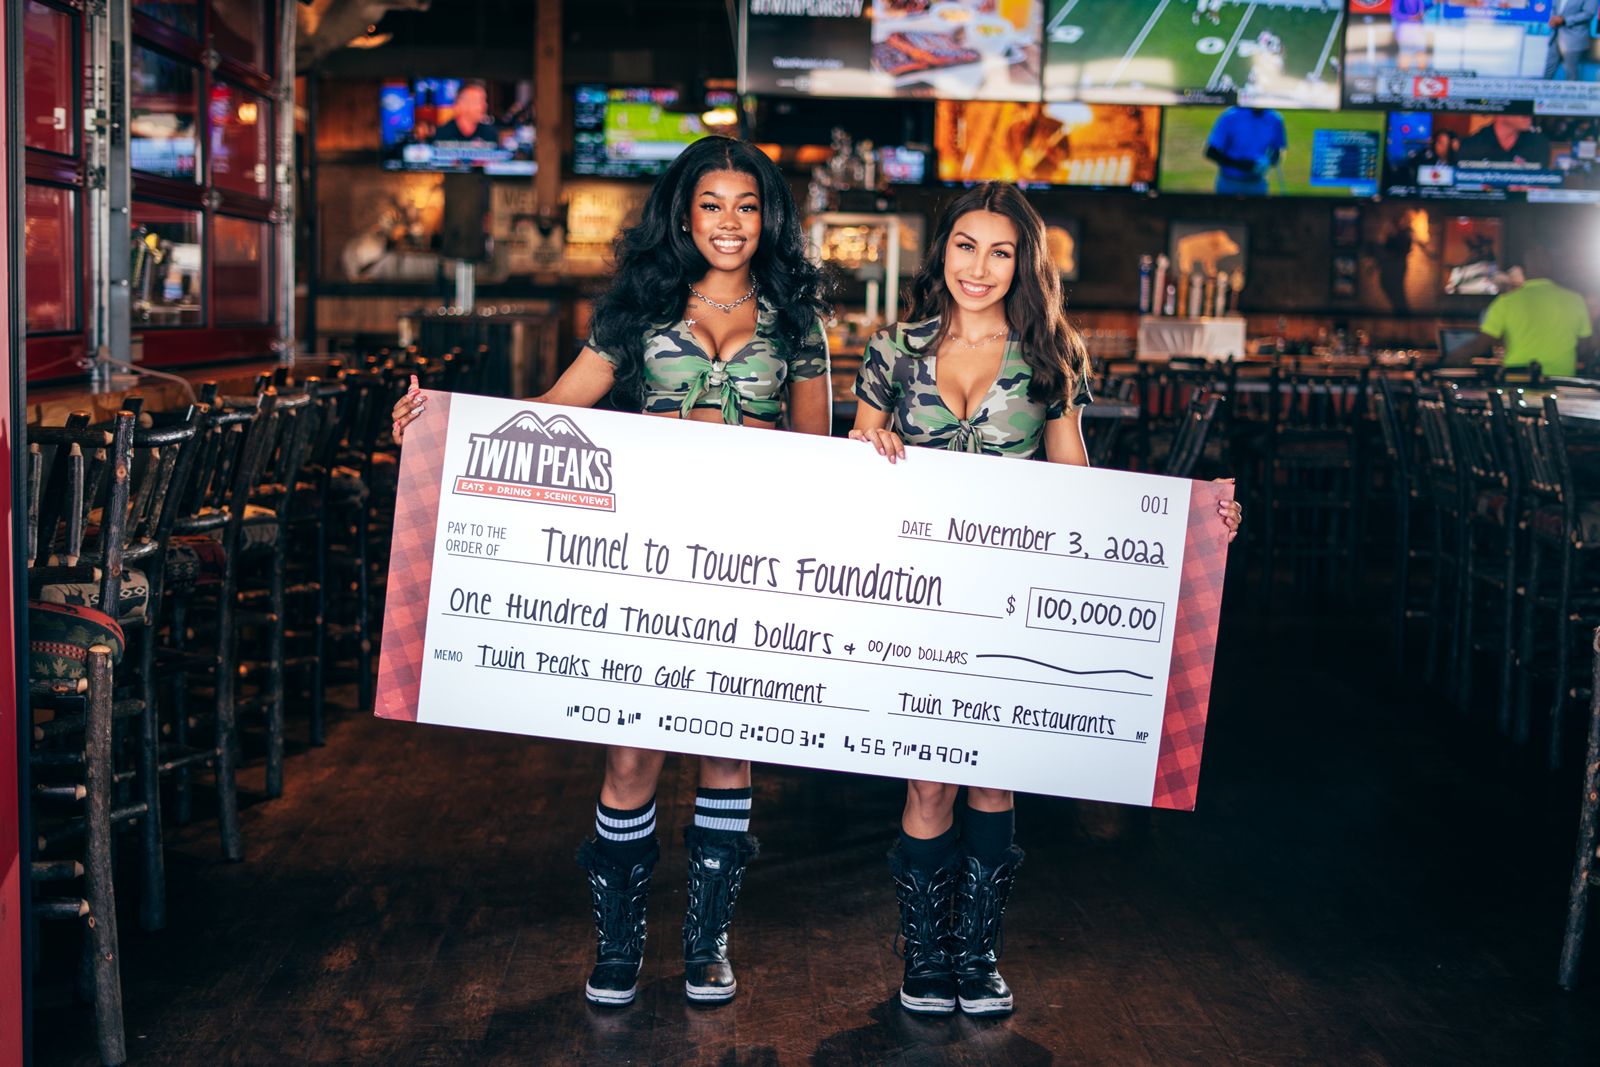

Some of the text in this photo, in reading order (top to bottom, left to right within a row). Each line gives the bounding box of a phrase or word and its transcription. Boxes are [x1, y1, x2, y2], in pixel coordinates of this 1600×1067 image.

[468, 436, 610, 492] TWIN PEAKS
[461, 482, 610, 506] EATS DRINKS SCENIC VIEWS
[1140, 494, 1169, 515] 001
[445, 538, 500, 556] ORDER OF
[447, 521, 507, 540] PAY TO THE
[901, 517, 1166, 565] DATE November 3, 2022
[541, 526, 942, 606] Tunnel to Towers Foundation
[449, 587, 492, 615] One
[505, 593, 608, 628] Hundred
[620, 606, 738, 644] Thousand
[754, 620, 833, 654] Dollars
[867, 639, 911, 662] 00/100
[918, 646, 969, 665] DOLLARS
[1005, 595, 1157, 631] $ 100,000.00
[433, 644, 827, 704] MEMO Twin Peaks Hero Golf Tournament
[898, 692, 1149, 741] Twin Peaks Restaurants MP
